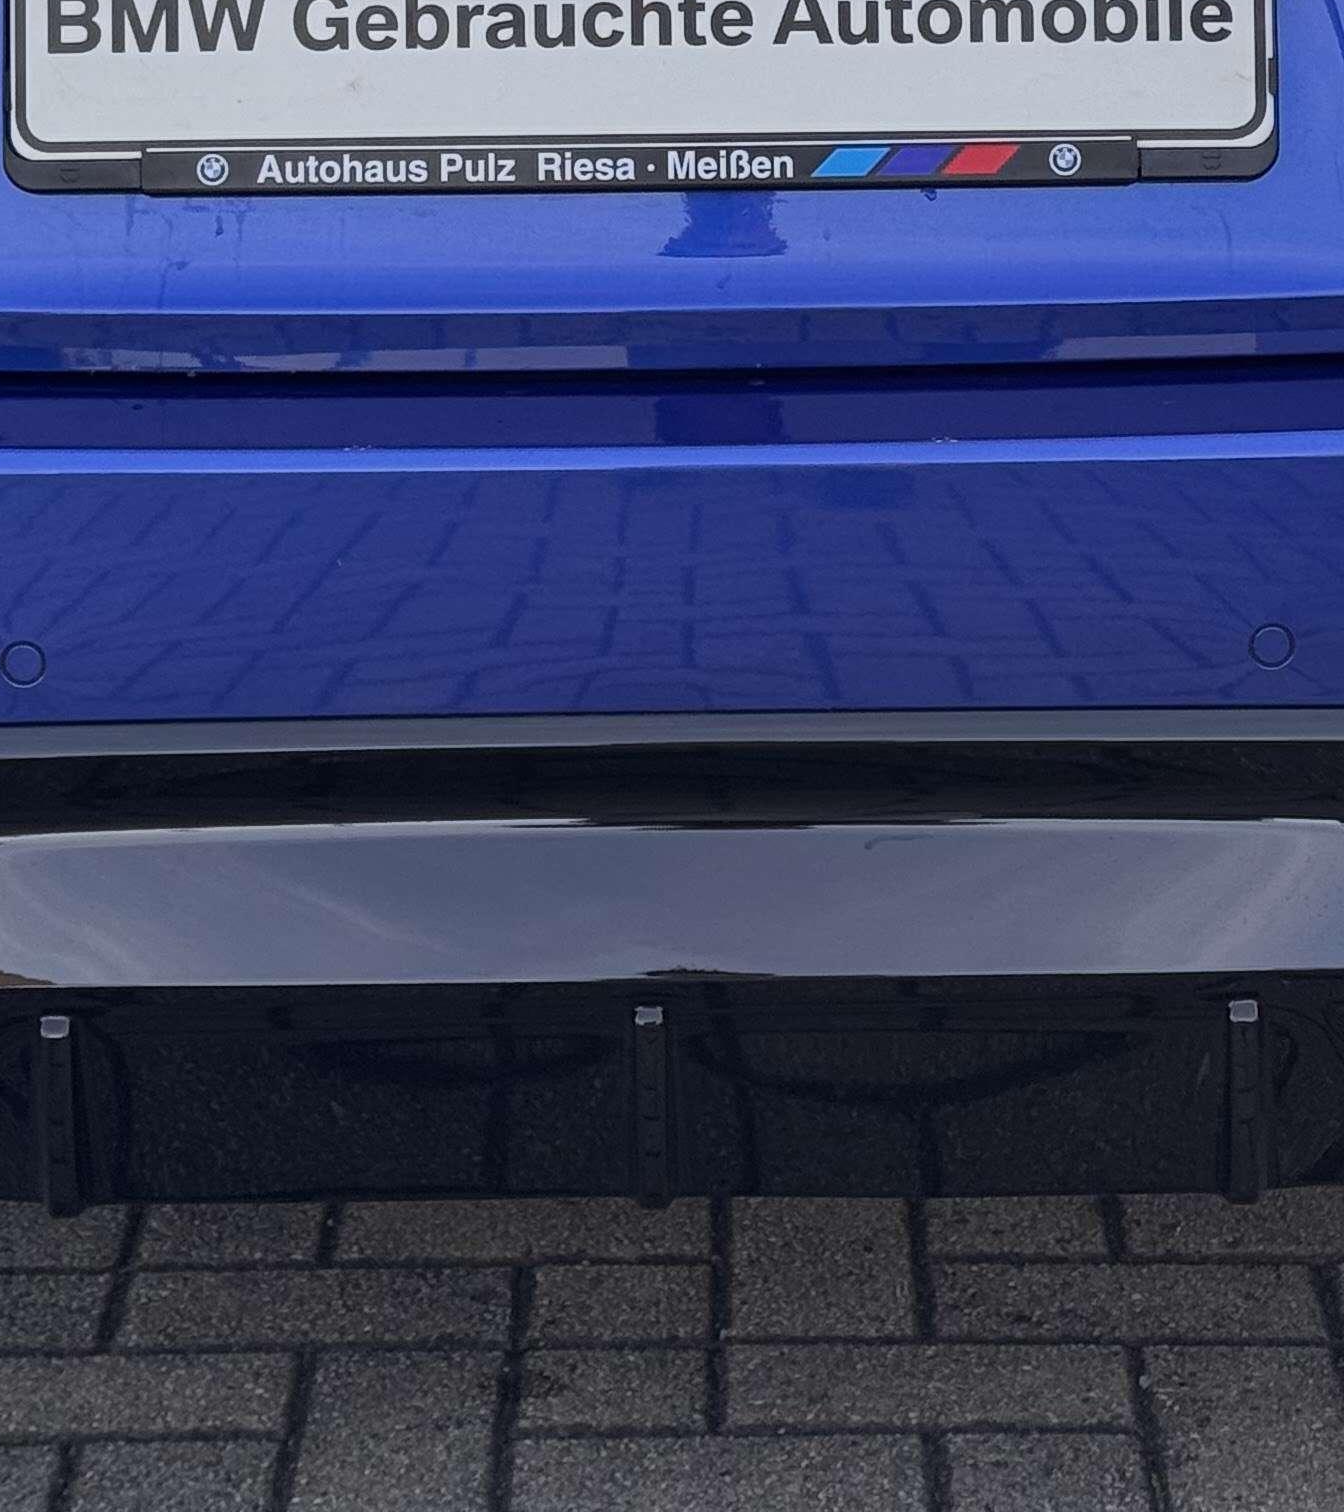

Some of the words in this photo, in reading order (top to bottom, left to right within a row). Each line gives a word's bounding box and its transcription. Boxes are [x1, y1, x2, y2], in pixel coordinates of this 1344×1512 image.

[256, 152, 429, 184] Autohaus
[440, 152, 516, 183] Pulz
[537, 151, 636, 182] Riesa
[667, 149, 794, 180] Meißen
